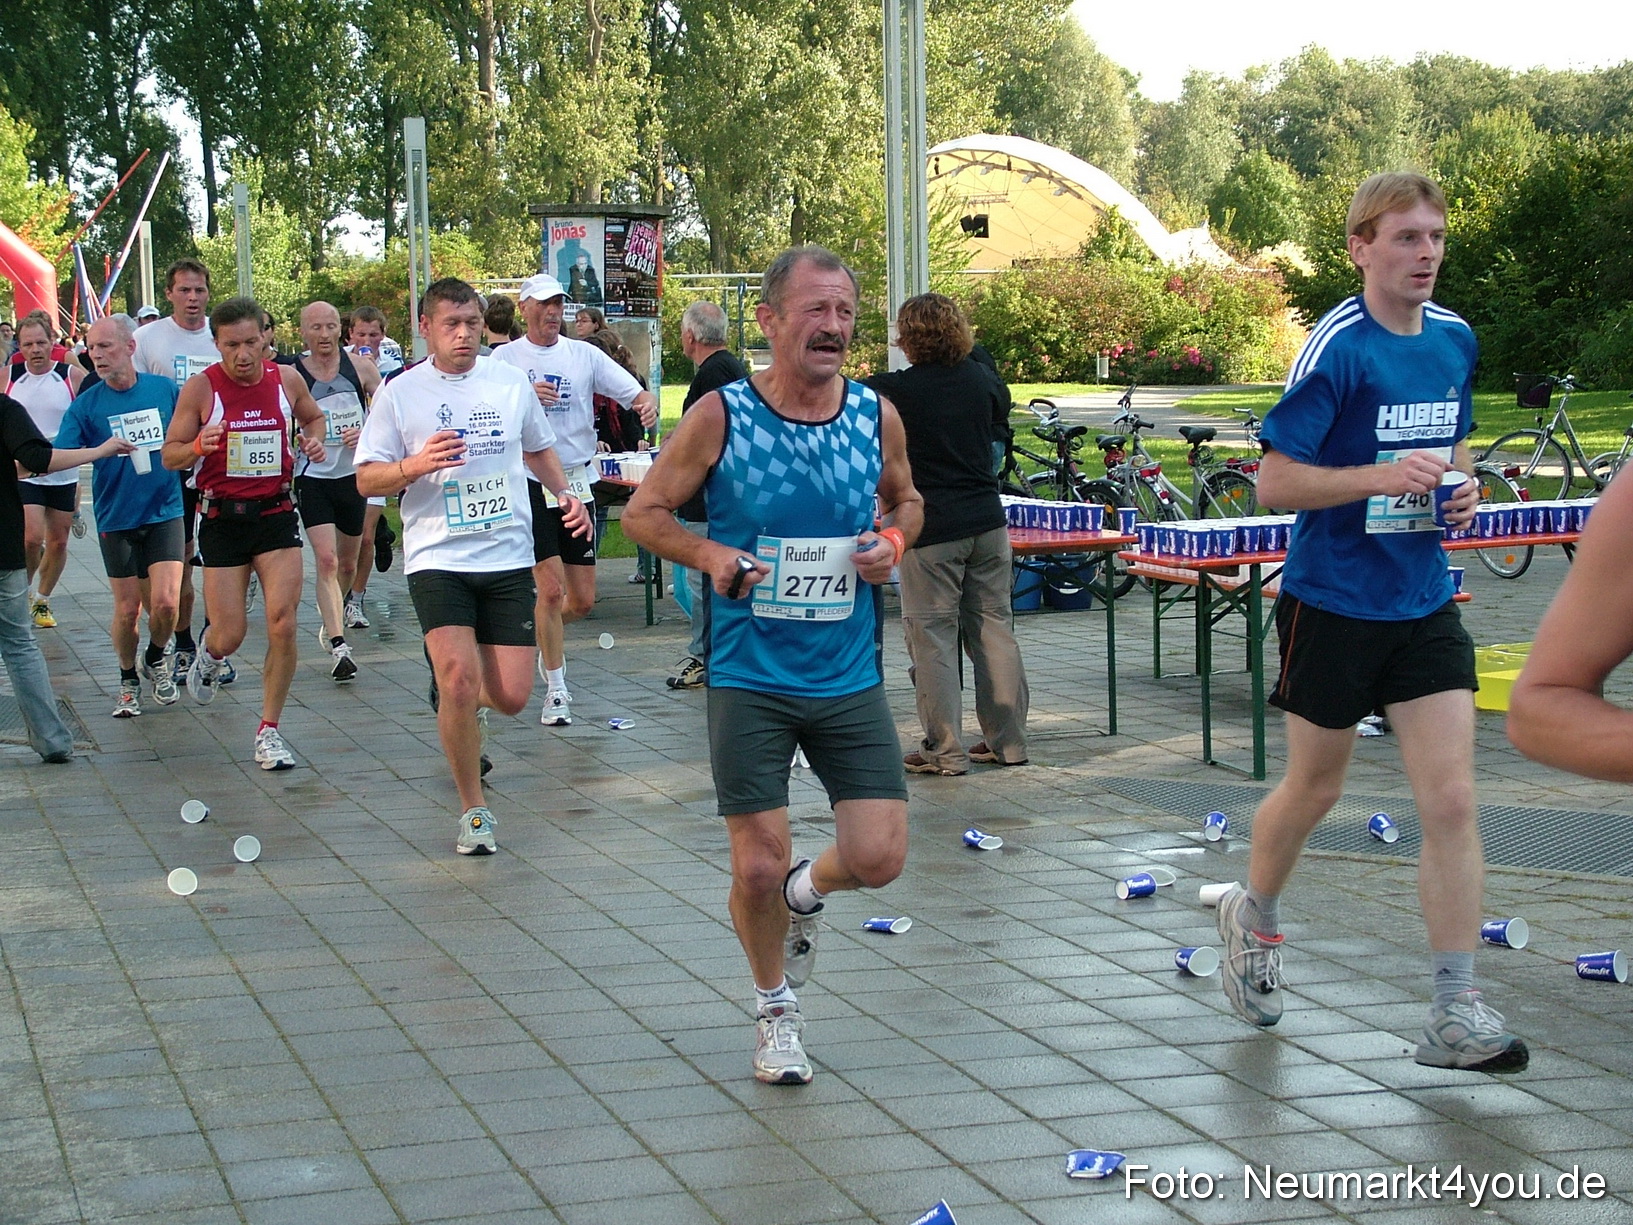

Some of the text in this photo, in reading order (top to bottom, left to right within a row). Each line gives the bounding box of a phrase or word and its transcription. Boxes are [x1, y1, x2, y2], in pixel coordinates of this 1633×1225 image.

[124, 415, 150, 425] Norbert
[244, 410, 262, 418] DAV
[1377, 402, 1459, 428] HUBER
[230, 418, 277, 429] Röthenbach
[468, 420, 503, 428] 16.09.2007
[129, 427, 161, 442] 3412
[1397, 427, 1453, 438] TECHNOLOGY
[243, 435, 274, 445] Reinhard
[249, 451, 275, 464] 855
[468, 447, 505, 457] Stadtlauf
[466, 478, 504, 495] RICH
[467, 496, 508, 518] 3722
[785, 546, 827, 561] Rudolf
[784, 574, 848, 597] 2774
